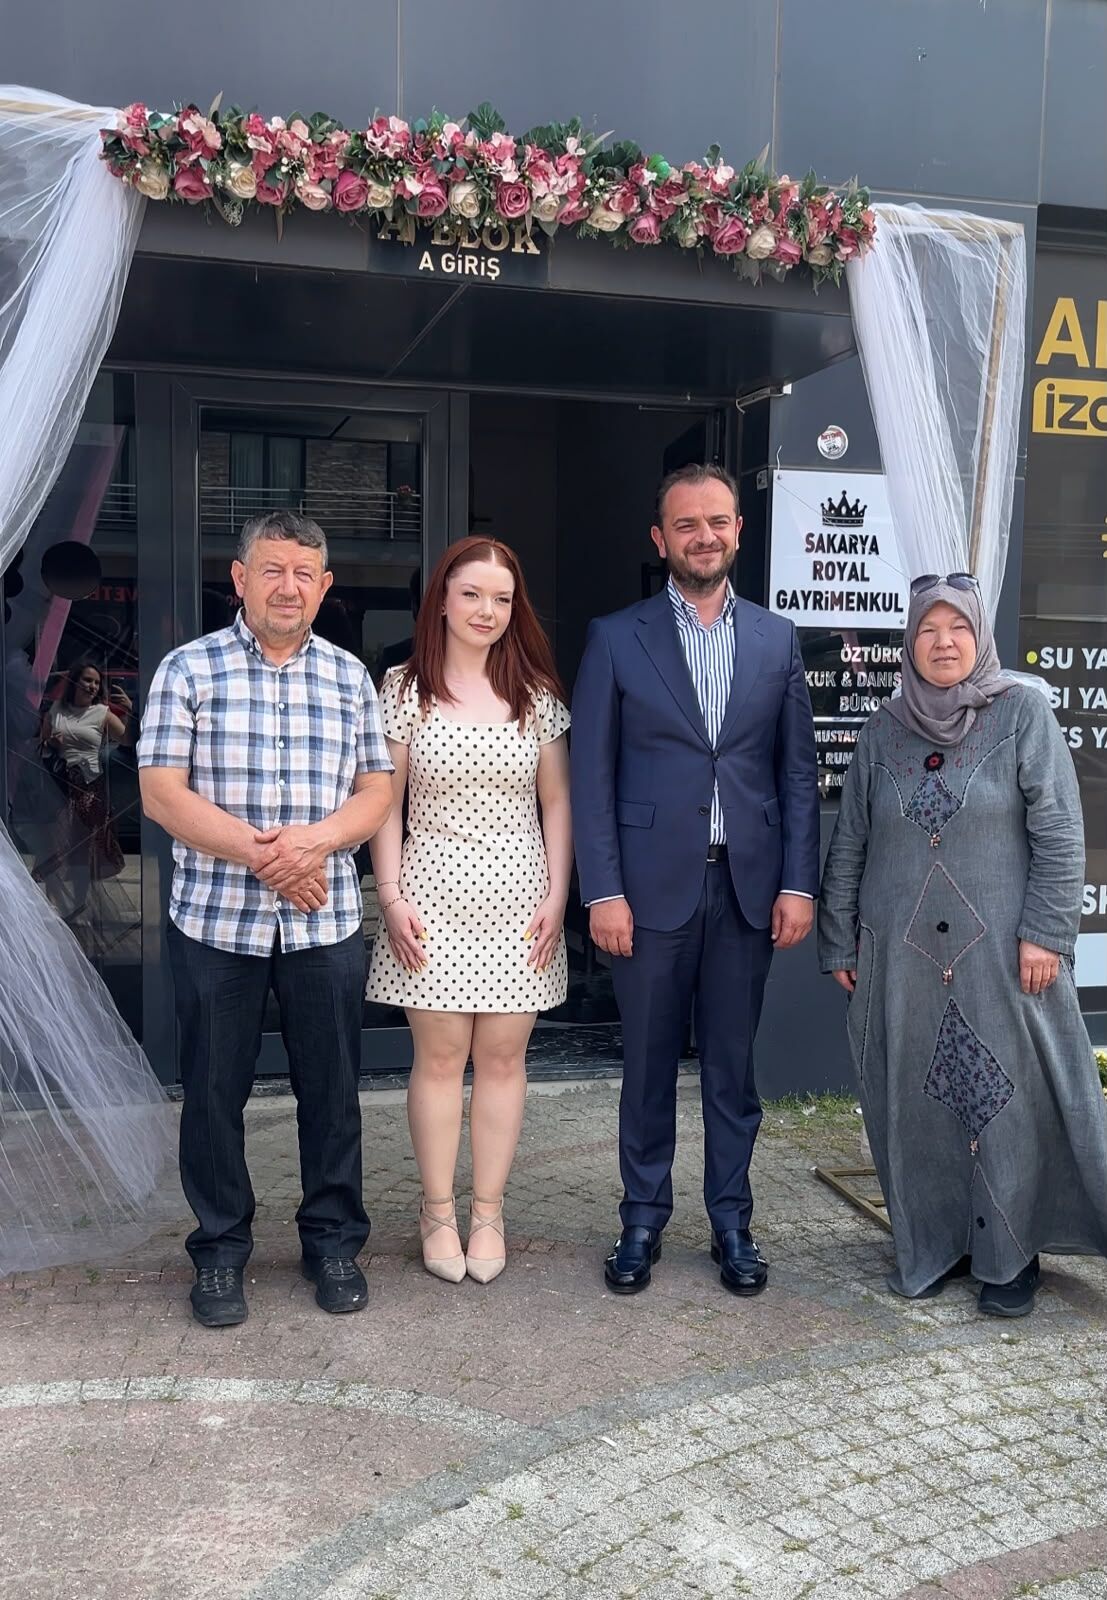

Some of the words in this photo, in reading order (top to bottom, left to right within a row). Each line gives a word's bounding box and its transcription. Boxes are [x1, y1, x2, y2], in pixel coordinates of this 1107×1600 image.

[418, 250, 435, 272] A
[805, 532, 879, 555] SAKARYA
[812, 561, 870, 582] ROYAL
[840, 643, 903, 663] ÖZTÜRK
[1040, 646, 1073, 669] SU
[841, 671, 852, 687] &
[814, 729, 860, 743] MUSTAF
[1091, 726, 1107, 748] Y
